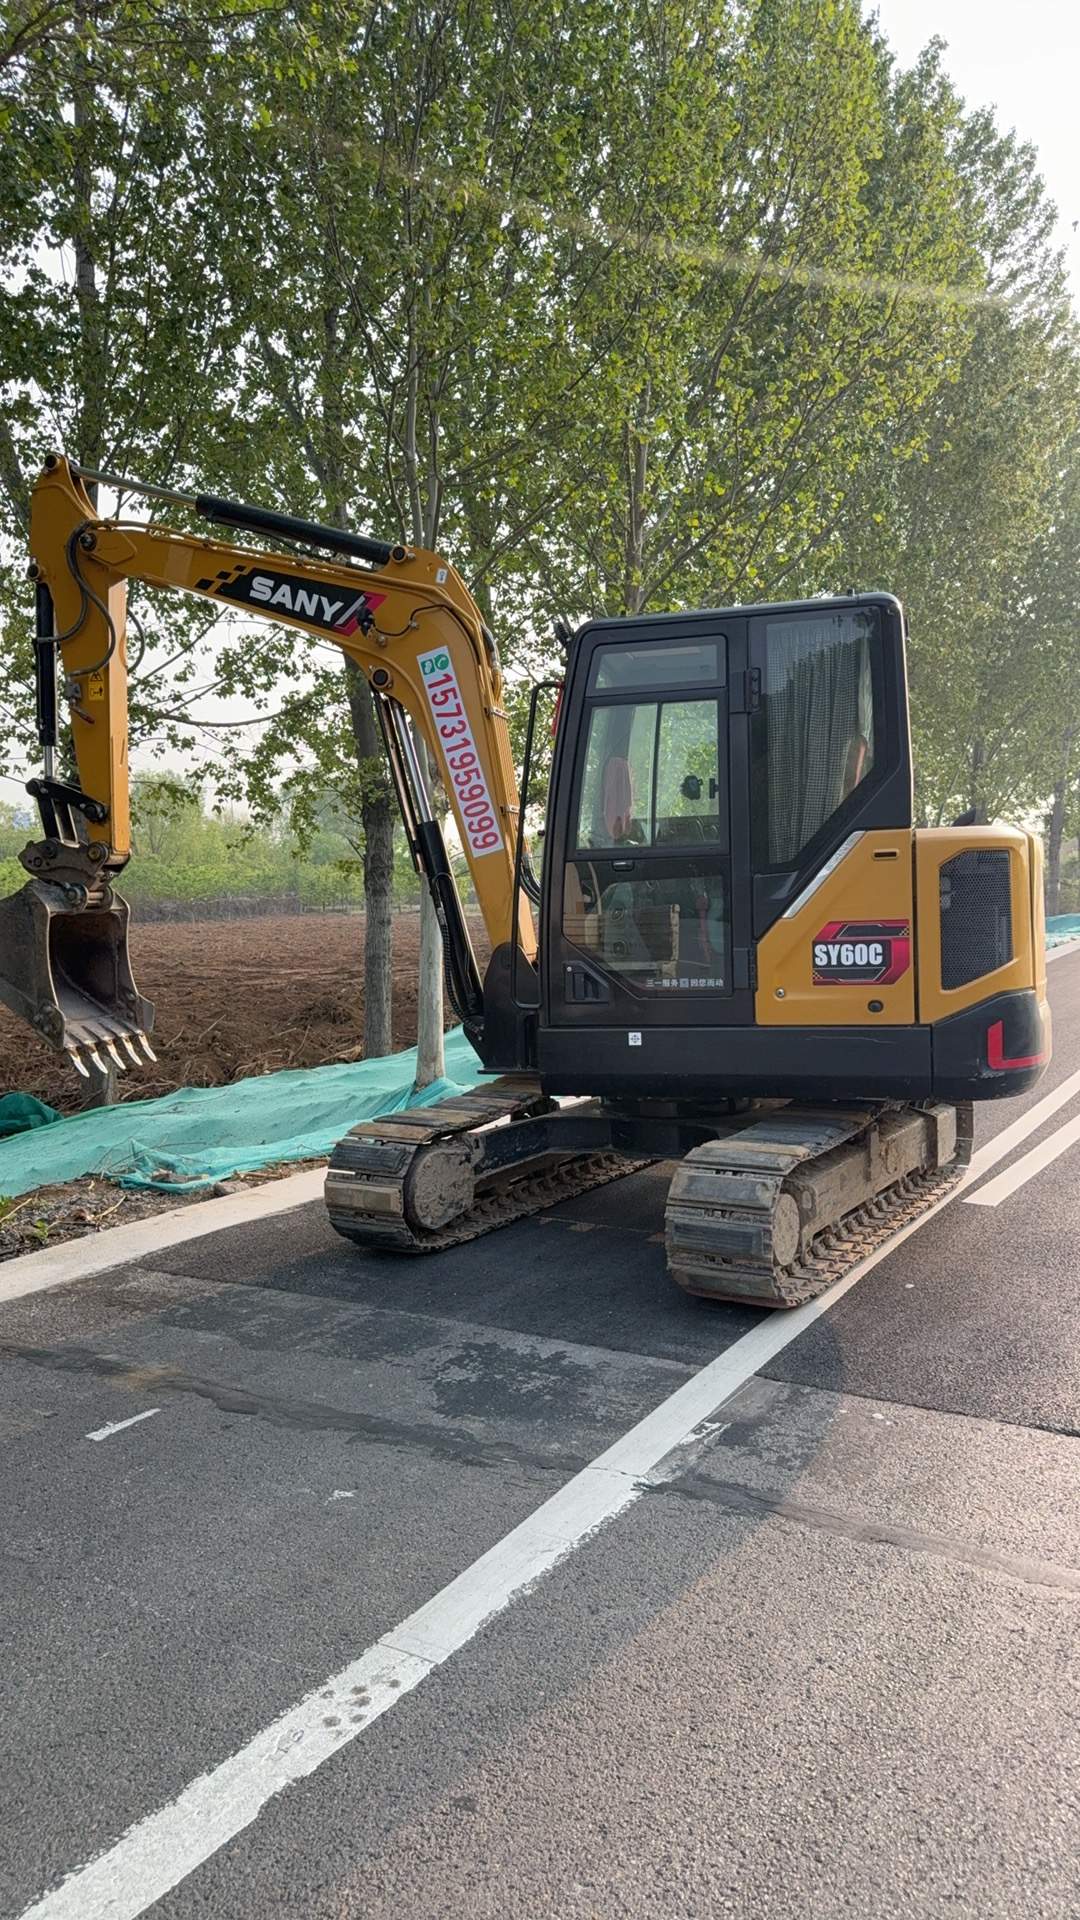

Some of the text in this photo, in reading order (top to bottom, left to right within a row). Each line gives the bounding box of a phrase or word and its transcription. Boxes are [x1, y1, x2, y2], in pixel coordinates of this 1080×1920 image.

[249, 576, 345, 623] SANY
[426, 673, 500, 850] 15731959099
[814, 943, 883, 966] SY60C
